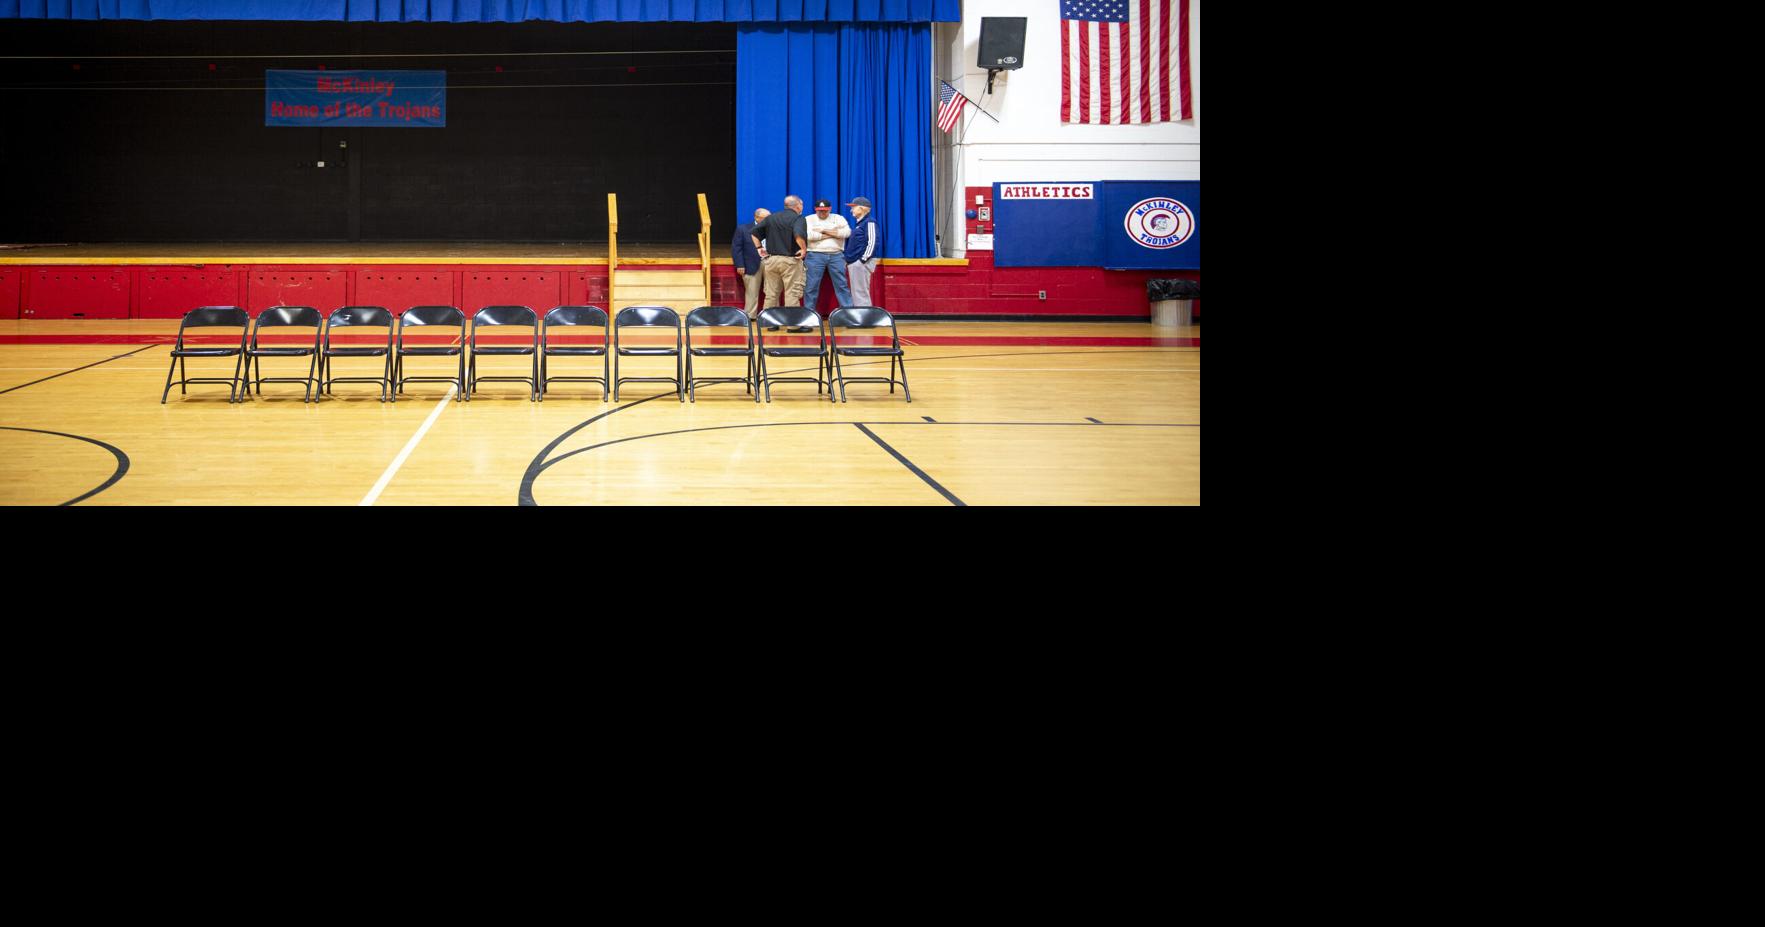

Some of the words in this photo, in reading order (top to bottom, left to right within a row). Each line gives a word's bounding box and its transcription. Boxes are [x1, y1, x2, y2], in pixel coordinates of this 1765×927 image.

[317, 77, 395, 96] McKinley
[271, 101, 319, 117] Home
[323, 101, 341, 117] of
[345, 101, 373, 117] the
[378, 101, 441, 121] Trojans
[1003, 186, 1090, 198] ATHLETICS
[1140, 233, 1180, 246] TROJANS
